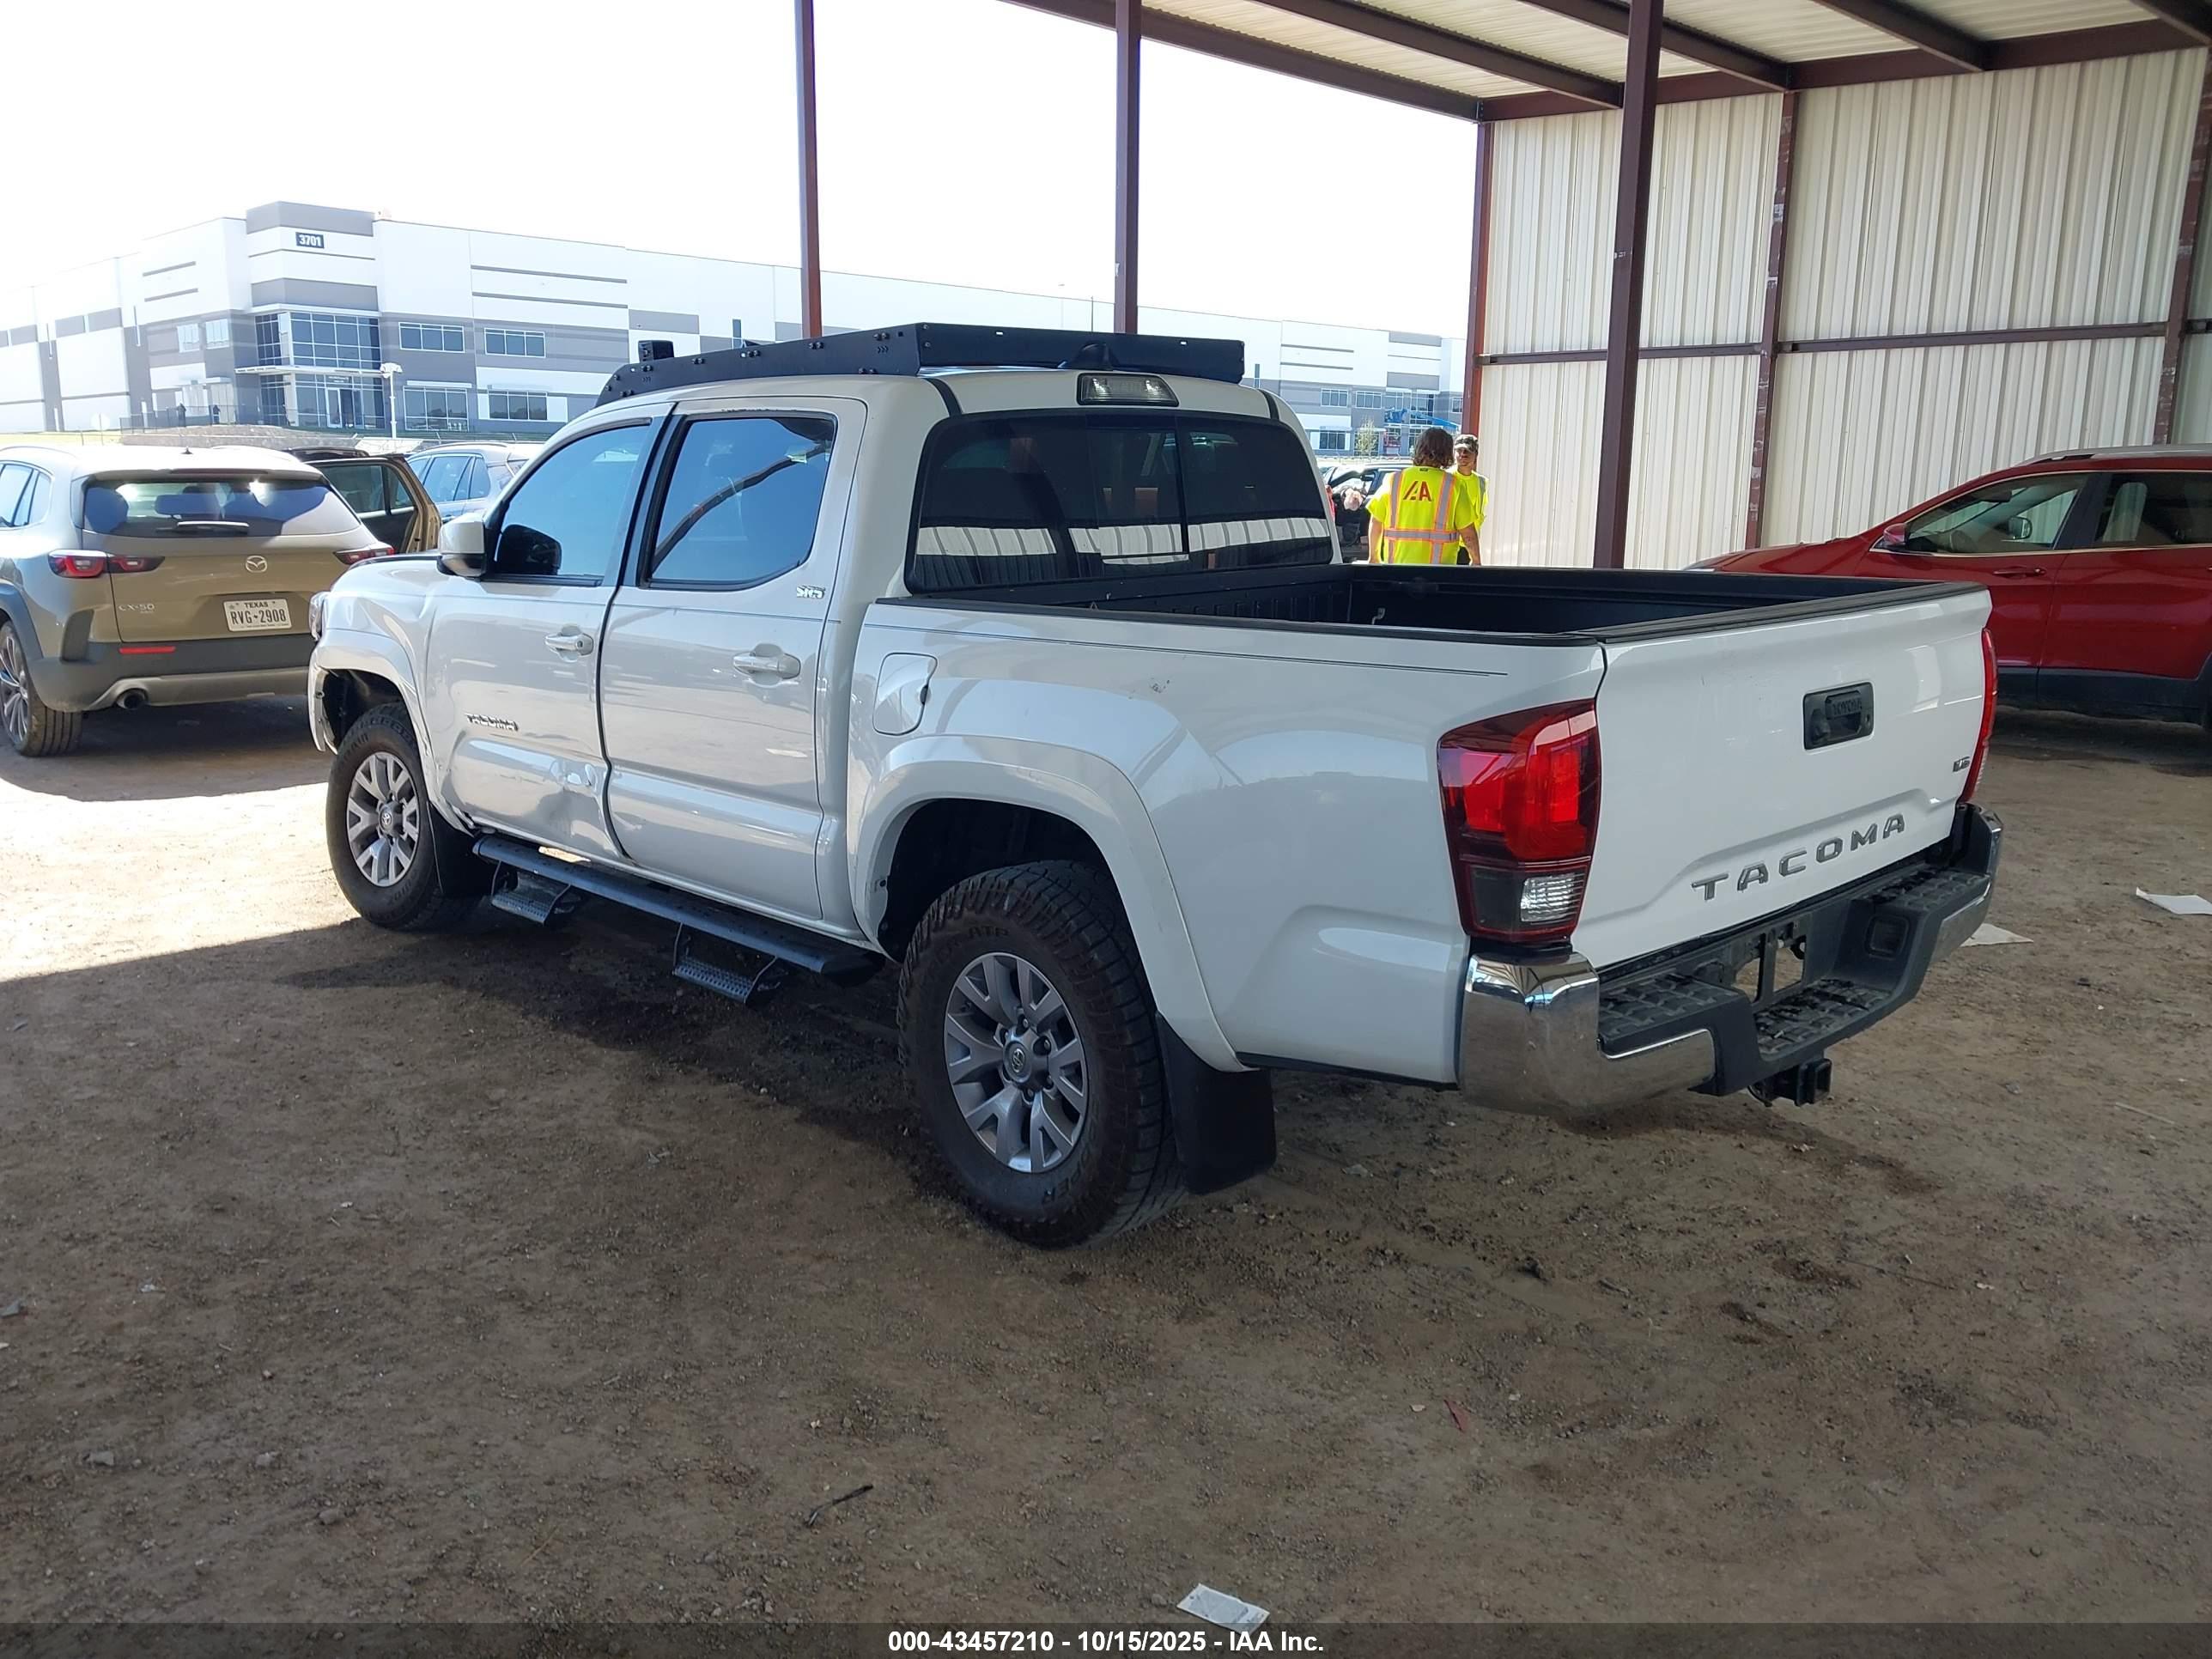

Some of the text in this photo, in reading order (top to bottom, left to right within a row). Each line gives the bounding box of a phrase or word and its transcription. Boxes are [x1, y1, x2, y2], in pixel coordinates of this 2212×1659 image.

[299, 234, 322, 247] 3701
[796, 585, 825, 599] SR5
[1692, 813, 1905, 901] TACOMA
